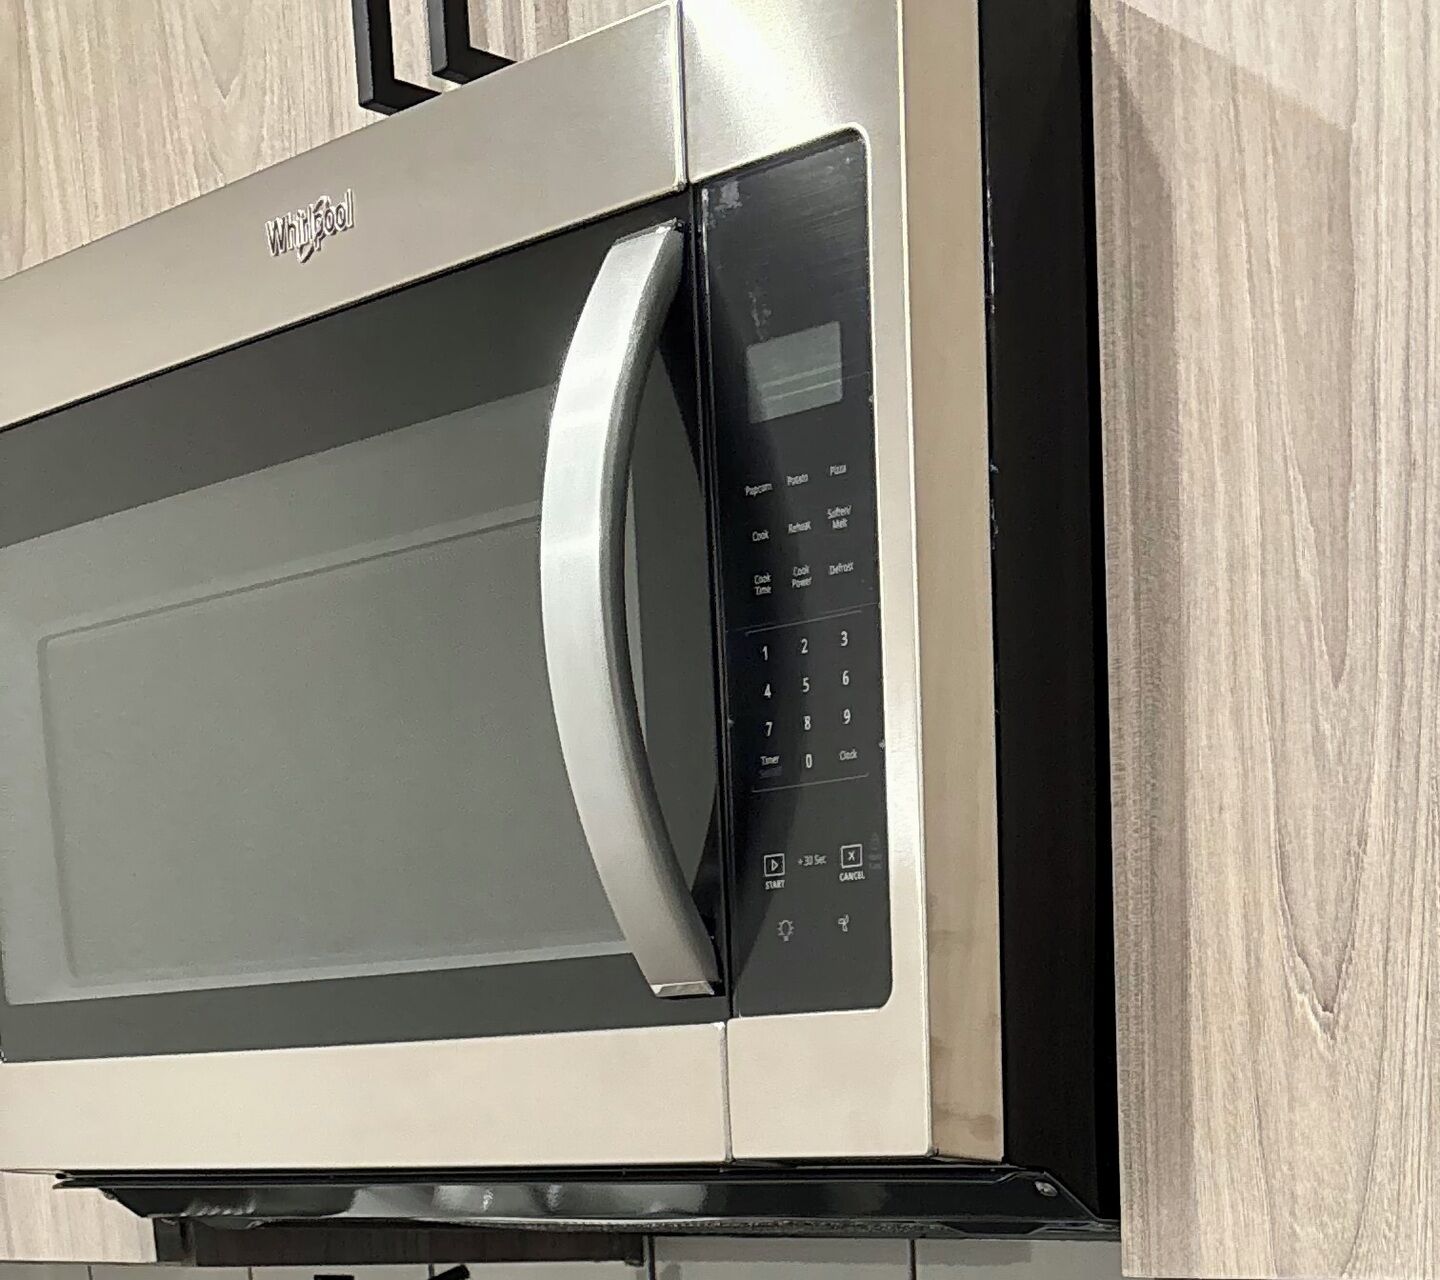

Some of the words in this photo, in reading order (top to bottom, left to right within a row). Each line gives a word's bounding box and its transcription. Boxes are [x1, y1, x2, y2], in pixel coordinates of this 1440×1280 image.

[265, 188, 356, 263] Whirlpool
[754, 573, 772, 585] Cook
[793, 565, 811, 577] Cook
[801, 638, 809, 654] 2
[840, 630, 849, 647] 3
[762, 645, 769, 661] 1
[802, 677, 810, 693] 5
[842, 670, 850, 686] 6
[764, 683, 772, 699] 4
[804, 715, 811, 730] 8
[843, 708, 851, 725] 9
[764, 722, 773, 737] 7
[805, 754, 813, 769] 0
[765, 879, 785, 890] START
[839, 871, 866, 882] CANCEL
